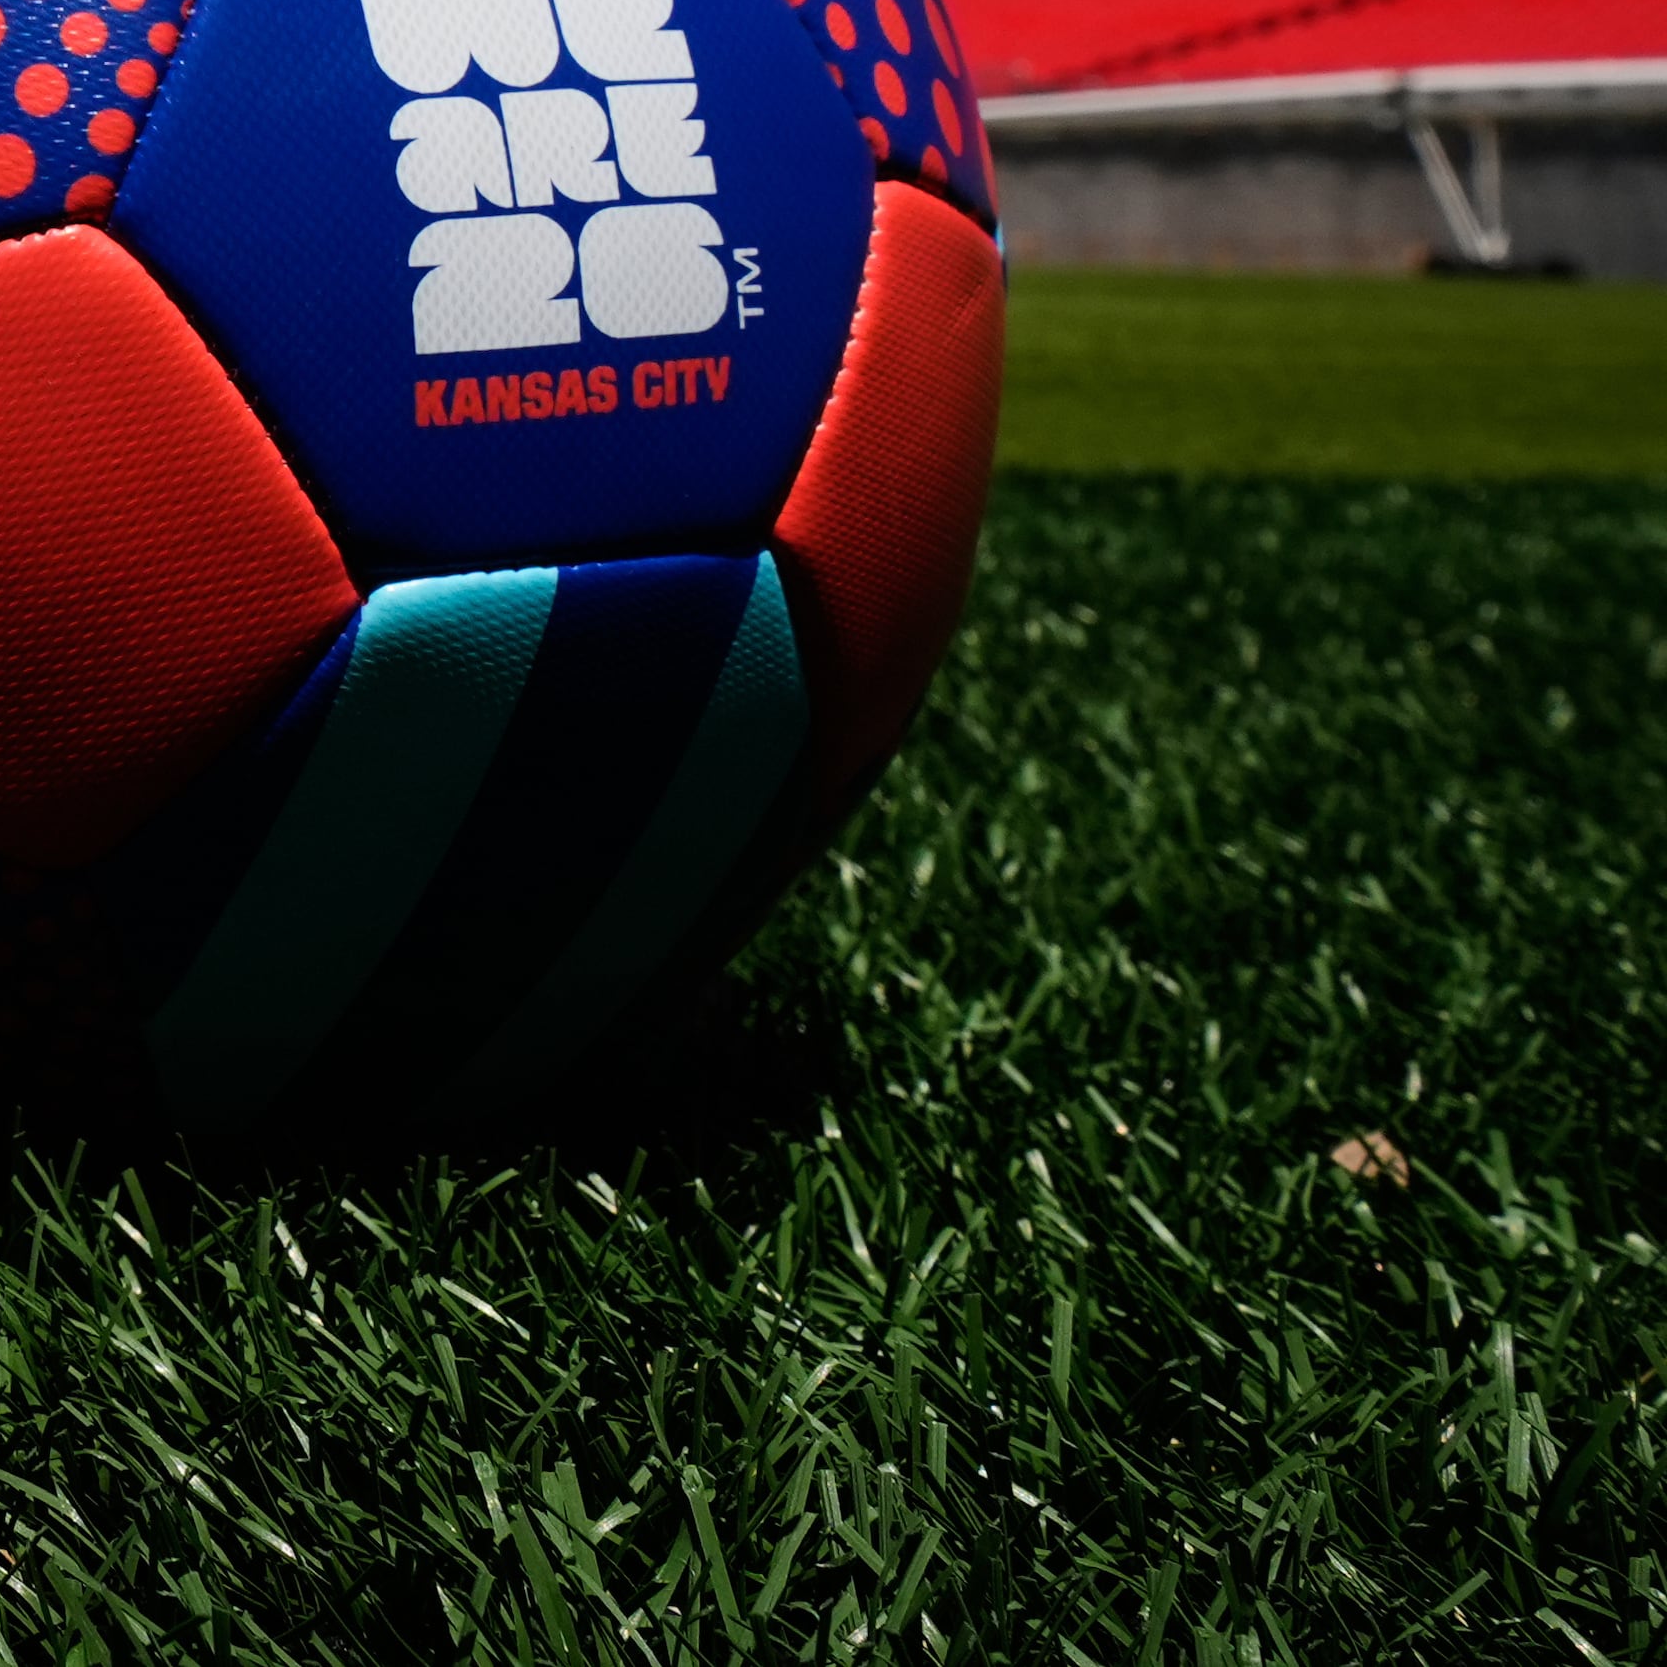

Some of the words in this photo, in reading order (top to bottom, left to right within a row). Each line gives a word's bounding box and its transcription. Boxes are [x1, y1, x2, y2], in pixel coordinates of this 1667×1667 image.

[389, 82, 718, 214] ARE
[407, 202, 729, 355] 26
[414, 364, 619, 428] KANSAS
[631, 356, 732, 410] CITY
